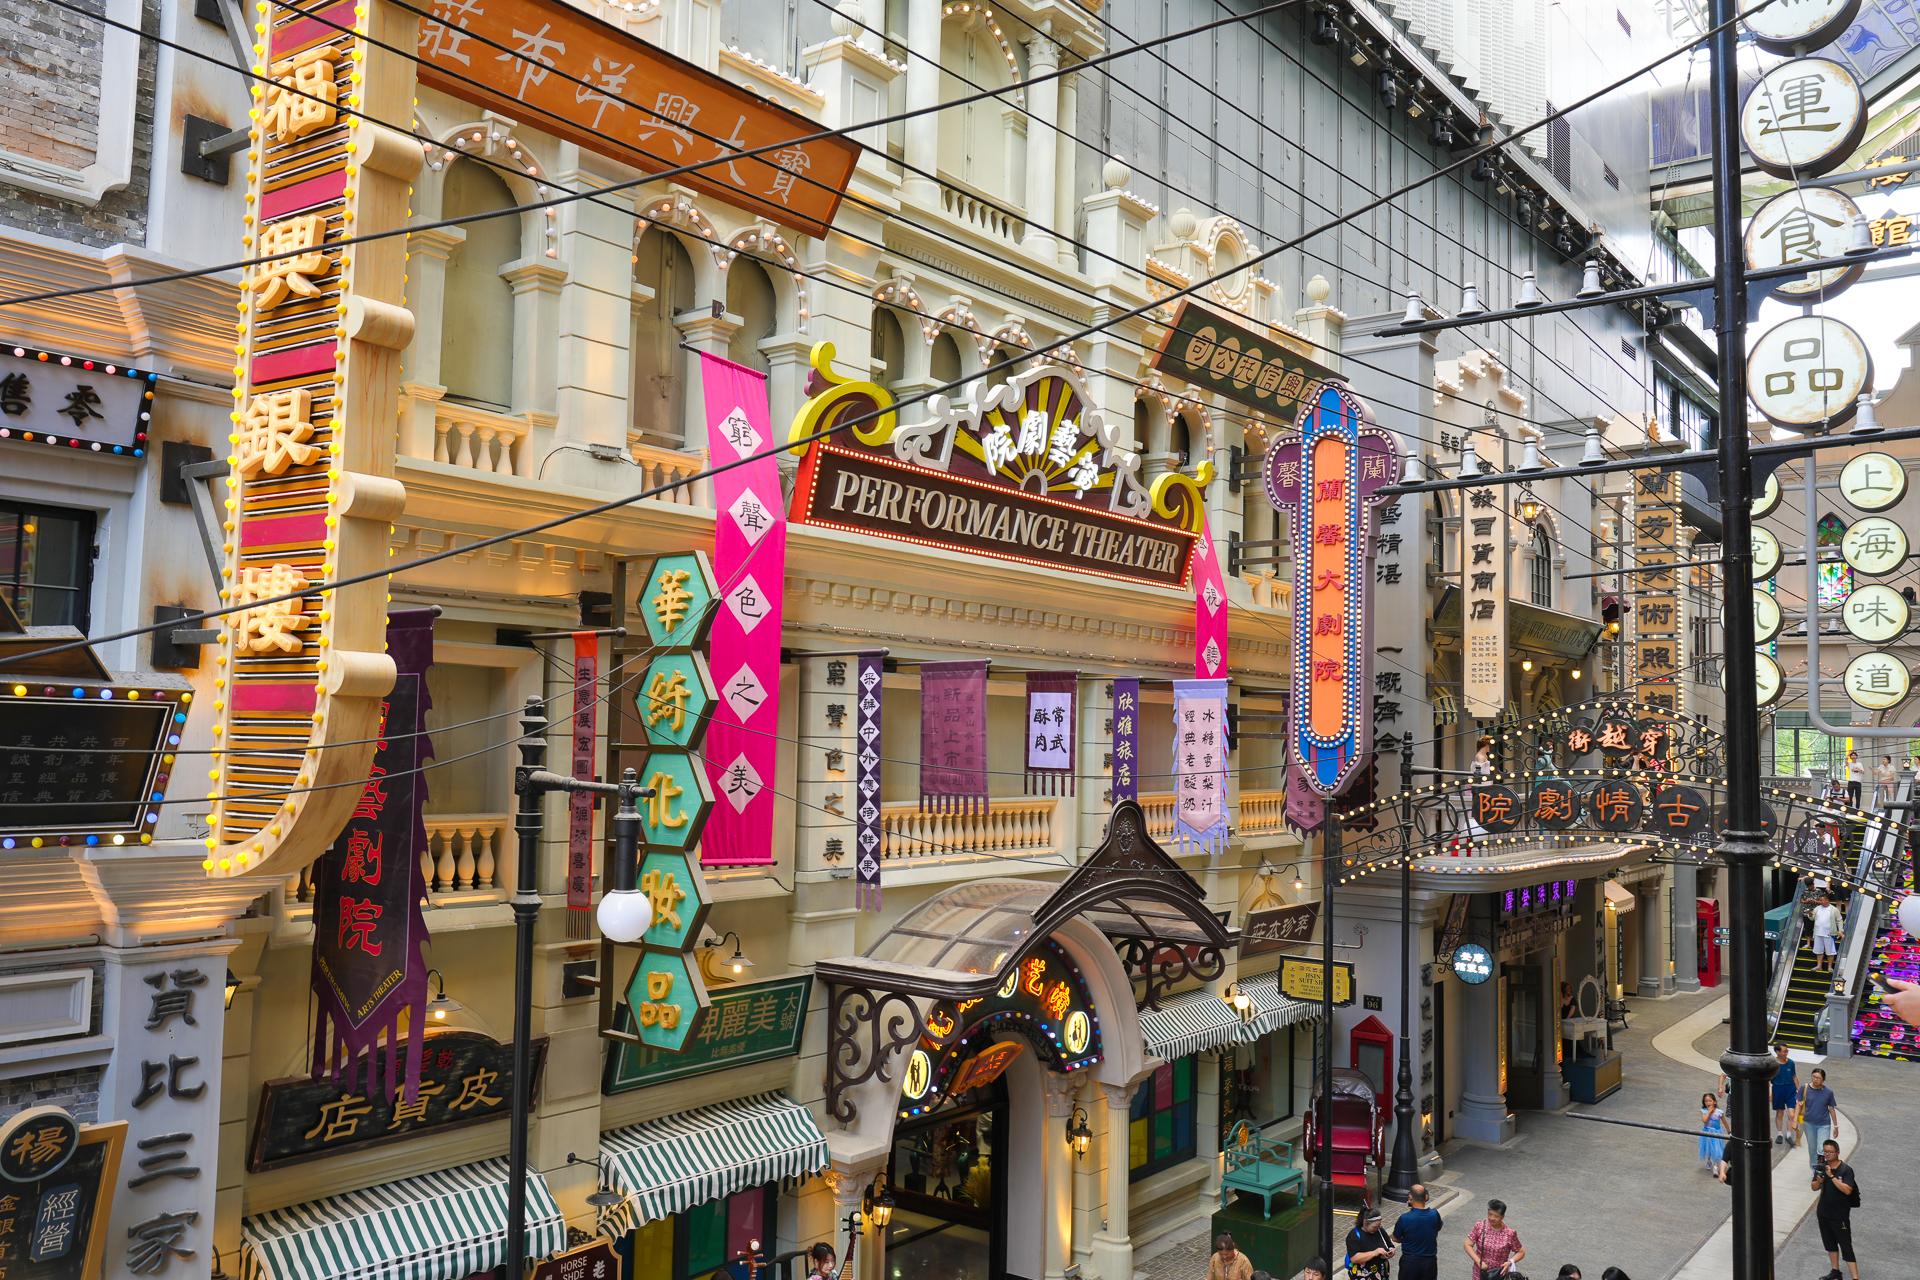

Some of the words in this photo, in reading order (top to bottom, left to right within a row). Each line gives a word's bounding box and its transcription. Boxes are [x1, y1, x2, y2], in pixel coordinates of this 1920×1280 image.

[1757, 0, 1845, 397] 運食品
[831, 469, 1066, 553] PERFORMANCE
[1073, 522, 1180, 575] THEATER
[1313, 478, 1344, 682] 蘭馨大劇院
[1850, 463, 1901, 697] 上海味道
[1479, 787, 1768, 828] 古情劇院
[372, 969, 403, 1001] THEATER
[126, 967, 208, 1275] 貨比三家
[37, 1188, 80, 1257] 經營
[560, 1255, 588, 1274] HORSE
